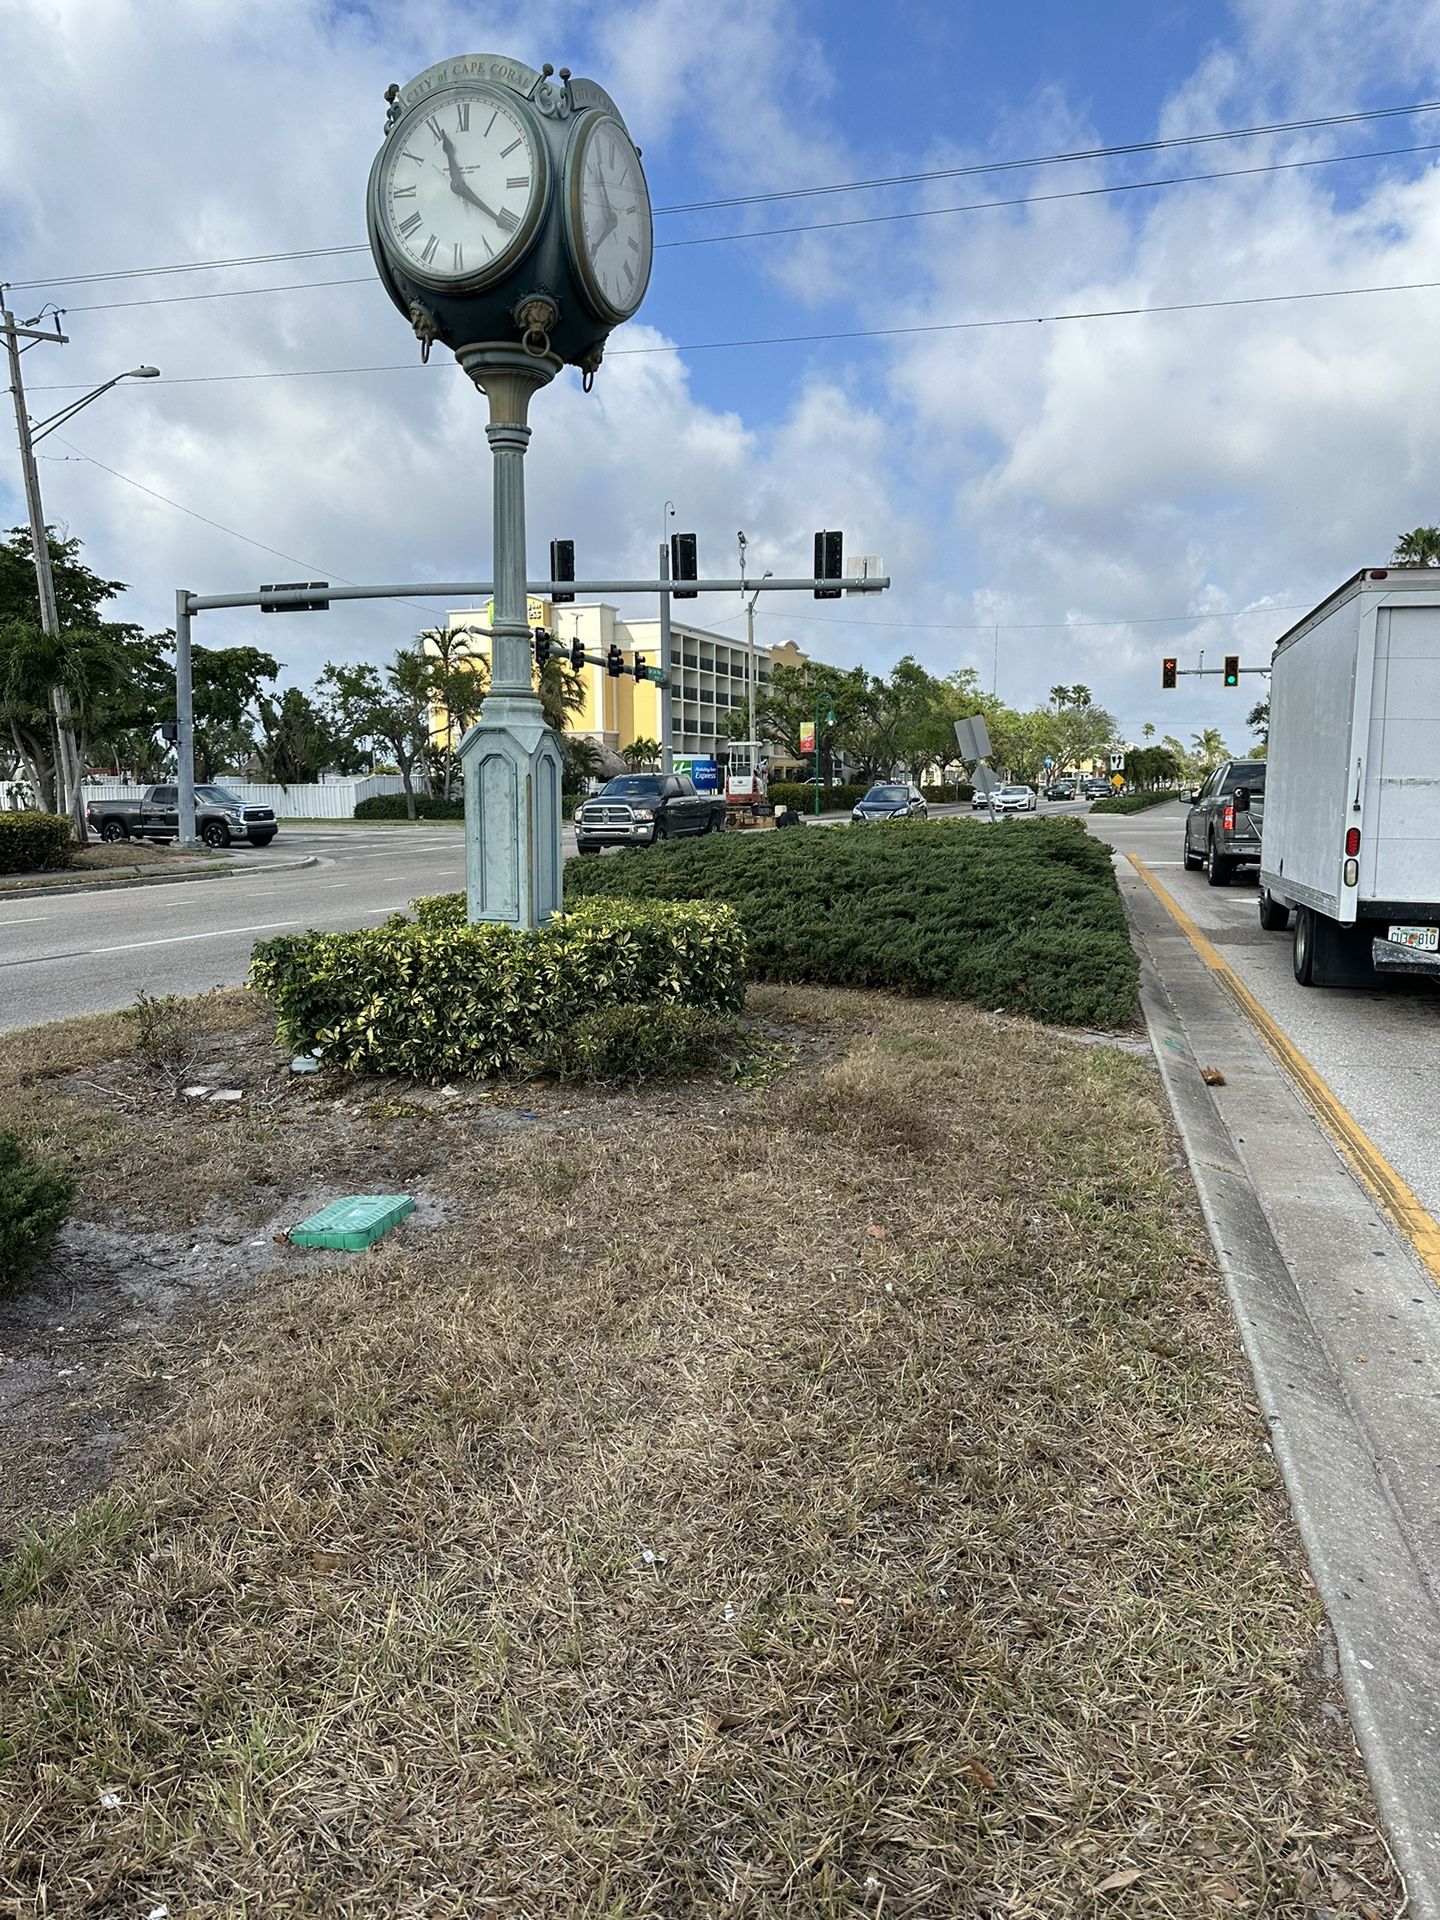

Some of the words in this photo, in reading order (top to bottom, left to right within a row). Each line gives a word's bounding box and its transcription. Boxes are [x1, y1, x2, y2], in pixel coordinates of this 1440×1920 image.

[406, 77, 432, 103] CITY
[437, 69, 448, 82] of
[452, 62, 485, 76] CAPE
[490, 63, 530, 90] CORAL
[456, 103, 471, 134] XII
[500, 137, 523, 159] II
[506, 176, 530, 189] III
[695, 771, 717, 781] Express
